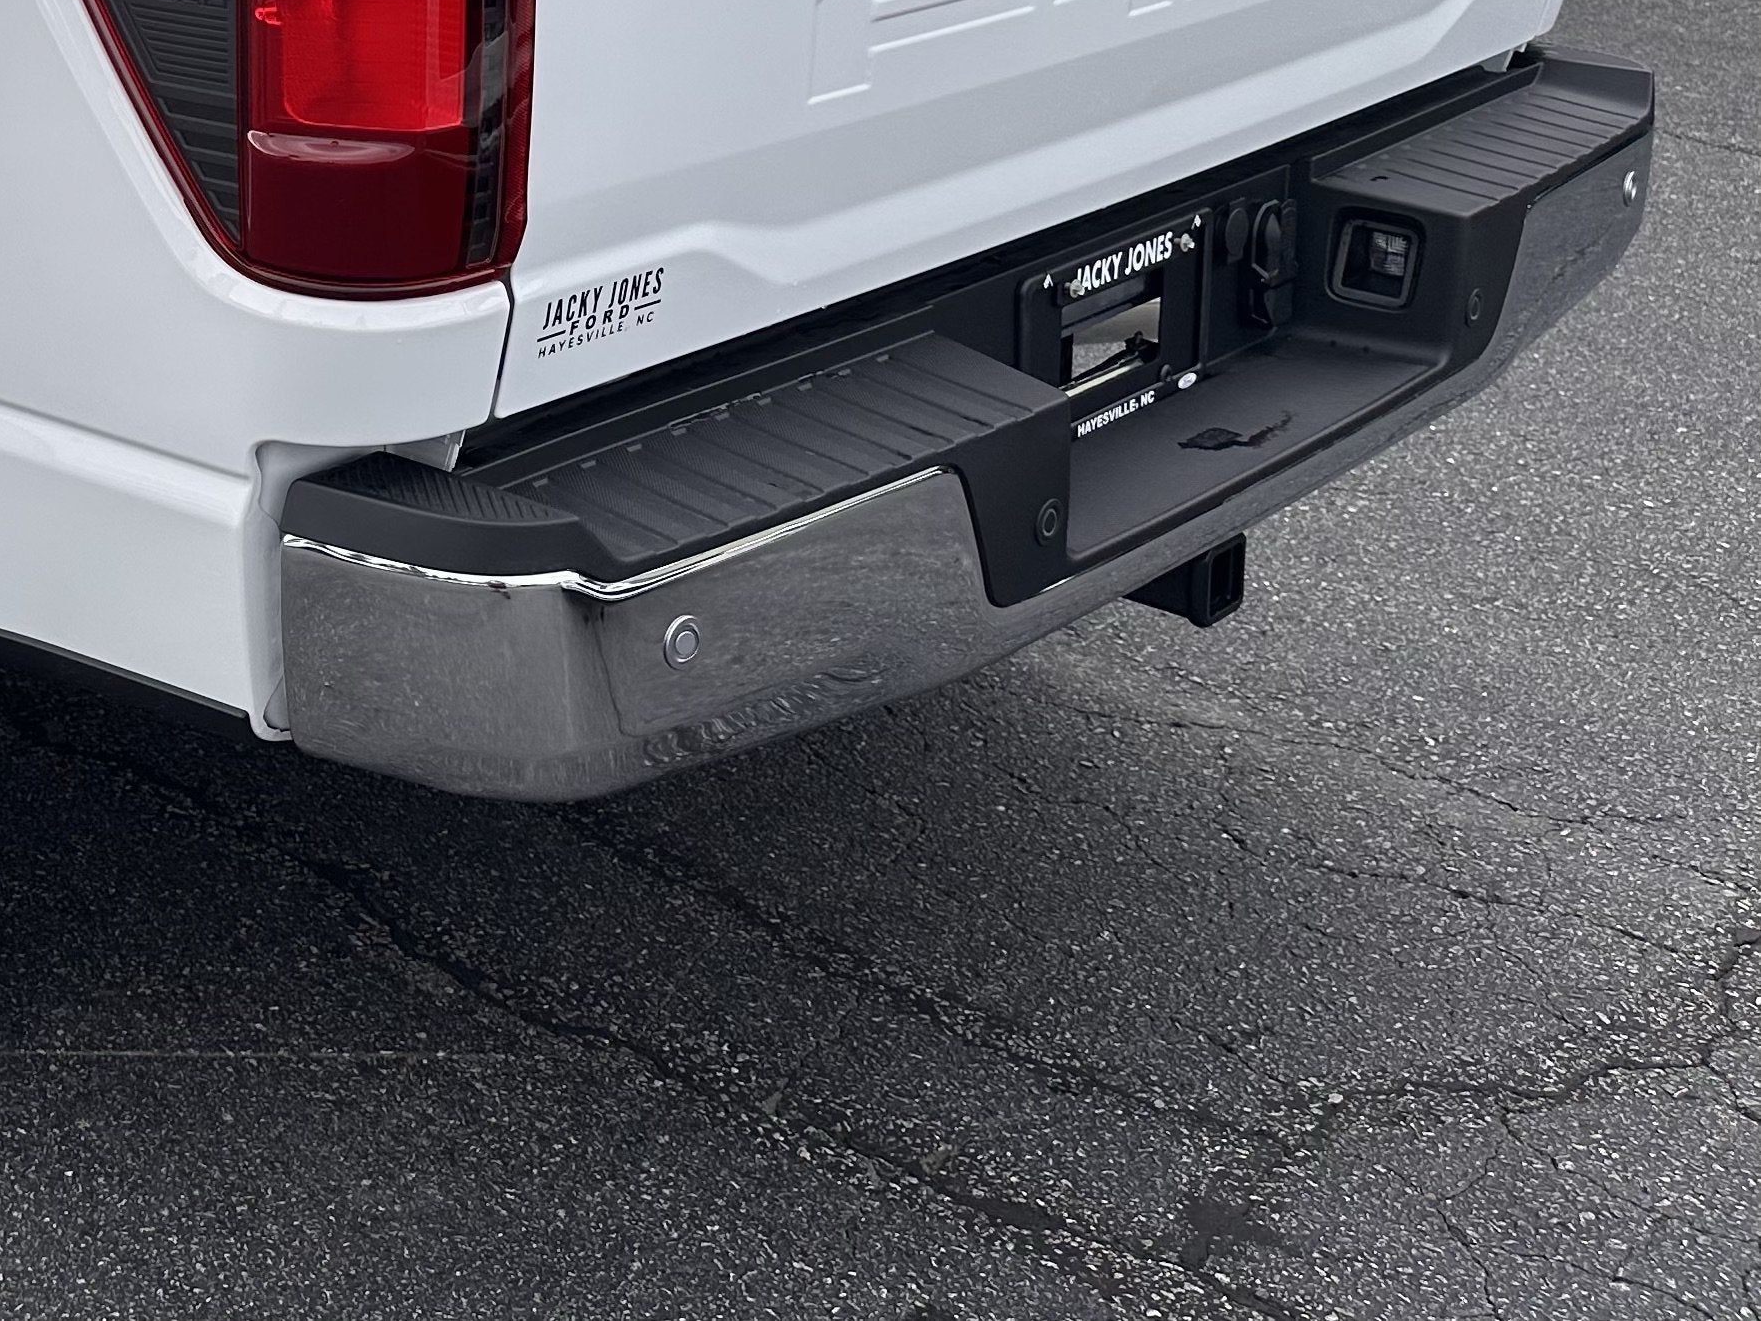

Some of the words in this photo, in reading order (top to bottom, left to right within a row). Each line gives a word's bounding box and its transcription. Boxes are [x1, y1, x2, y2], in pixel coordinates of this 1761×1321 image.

[1124, 231, 1173, 276] JONES
[542, 284, 603, 330] JACKY
[607, 266, 665, 309] JONES
[569, 304, 630, 336] FORD
[636, 310, 655, 326] NC
[1077, 398, 1139, 437] HAYESVILLE,
[1140, 390, 1155, 407] NC
